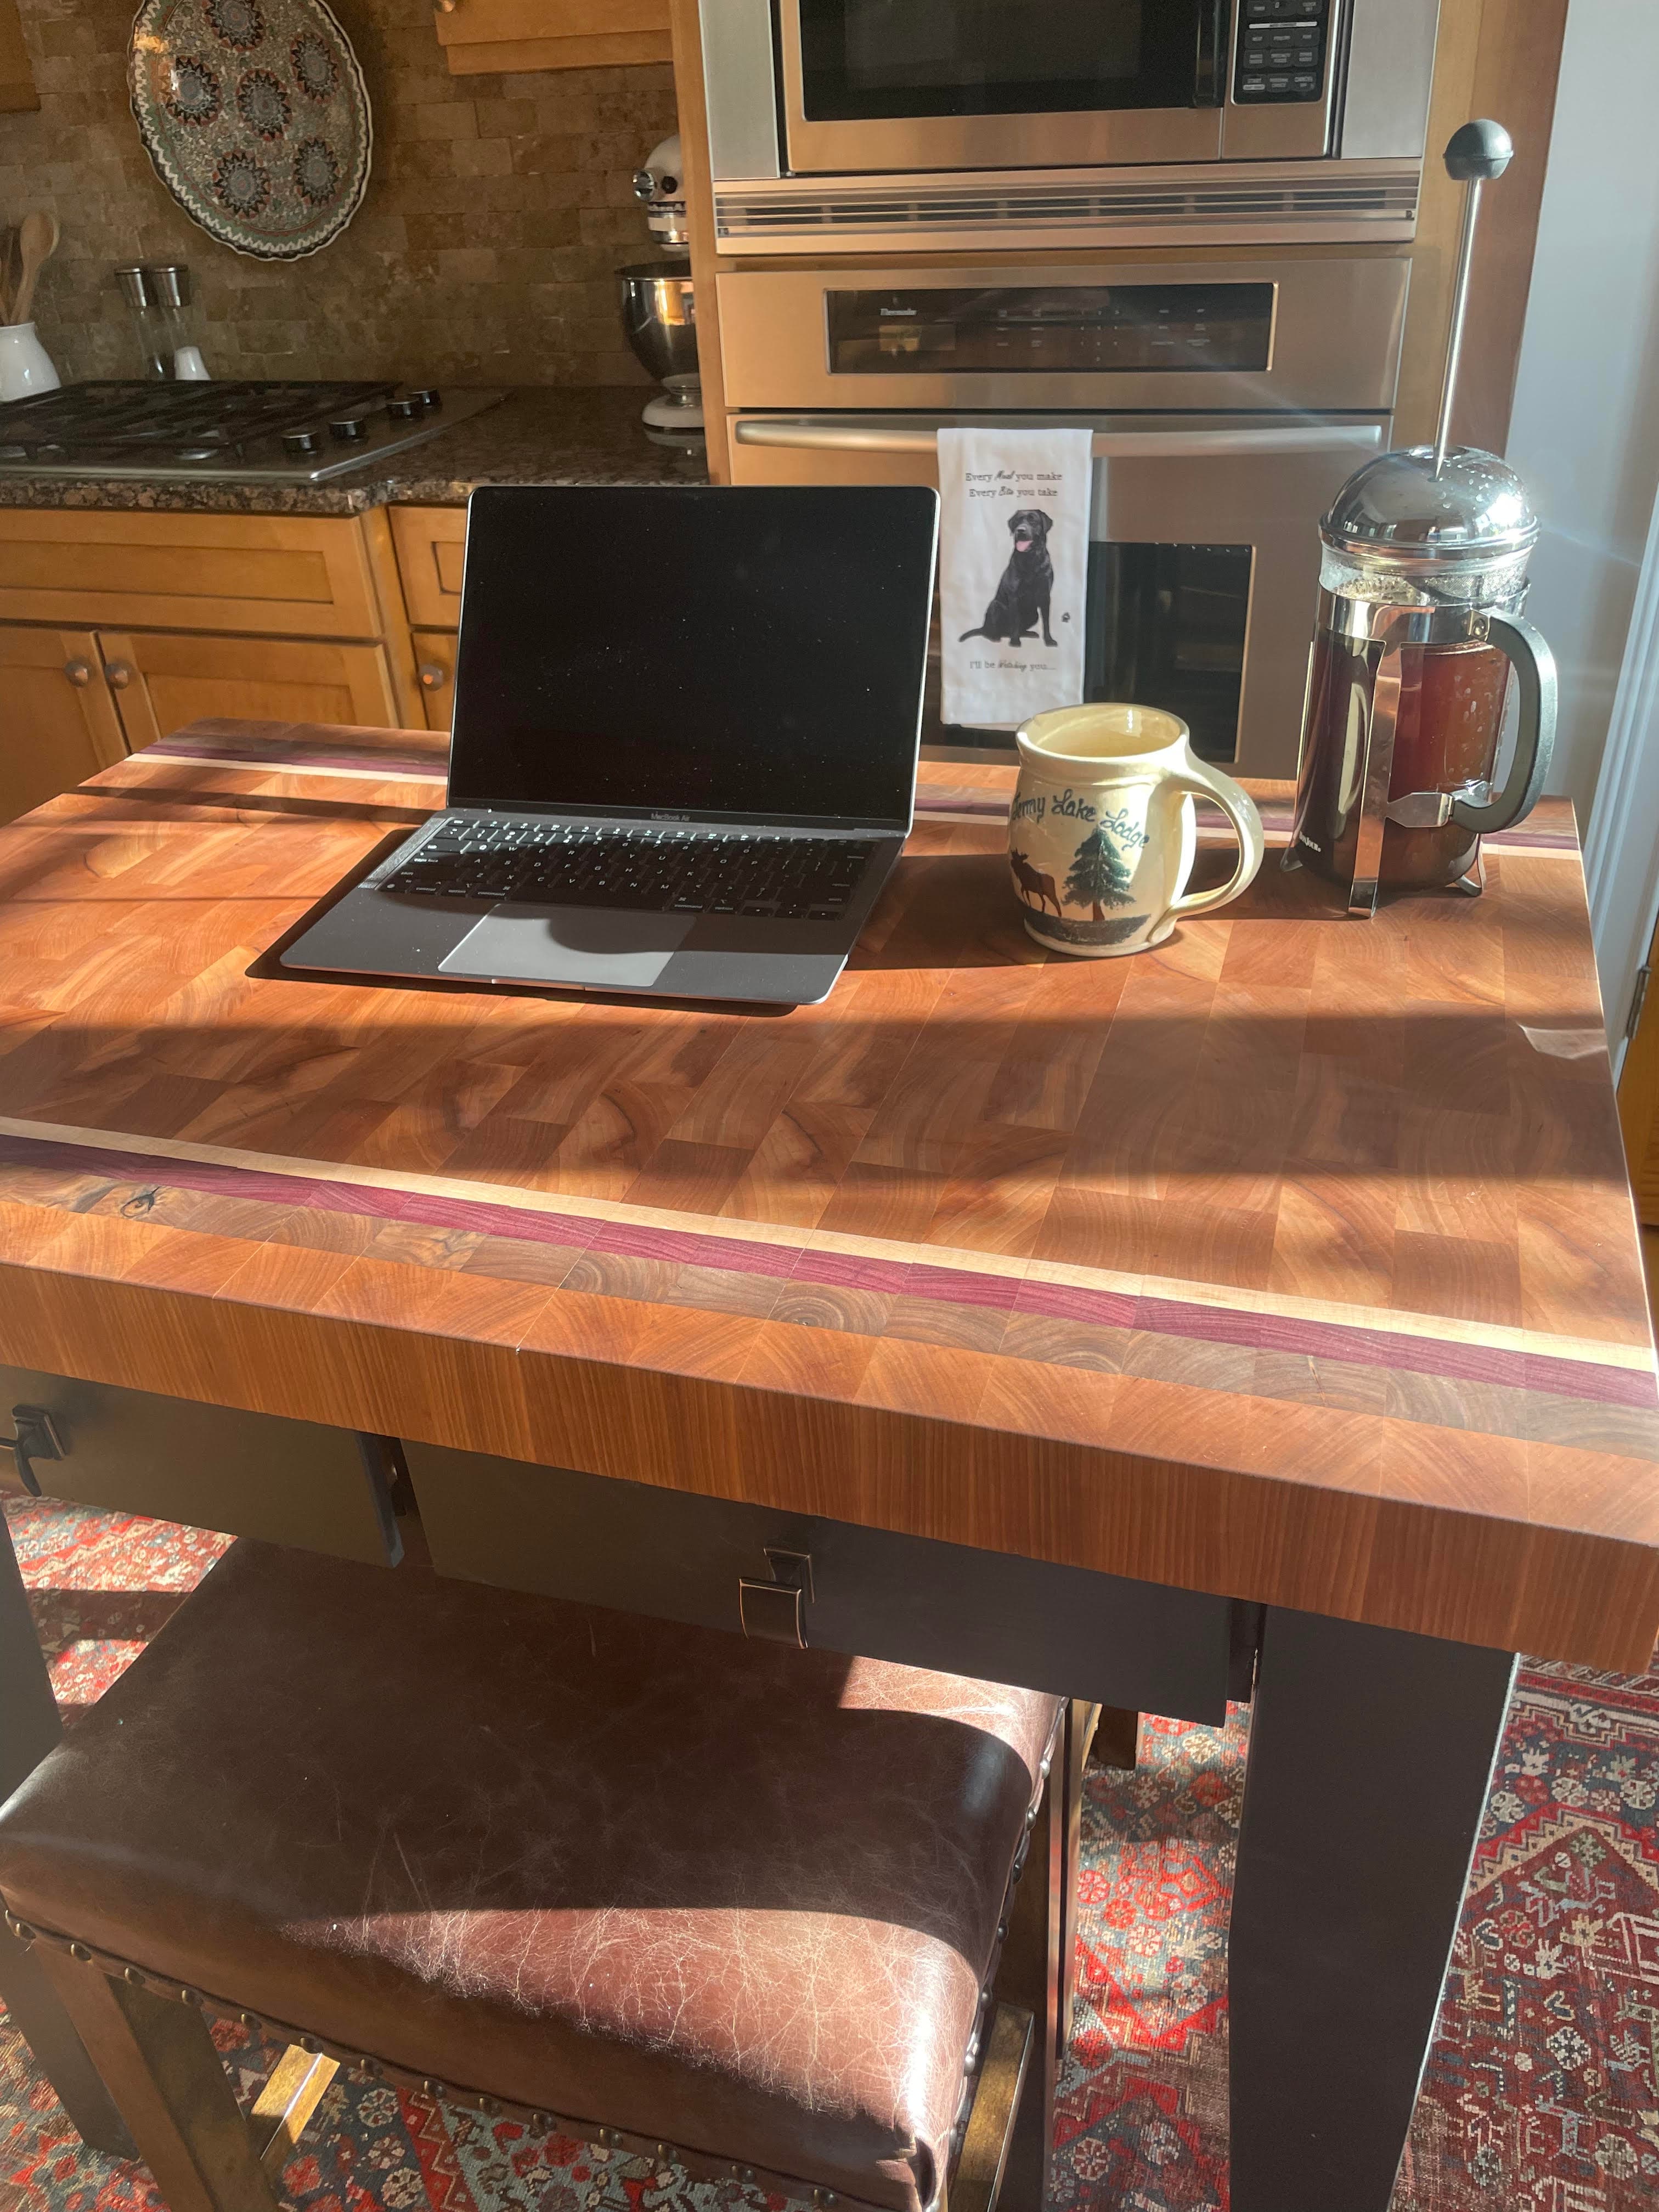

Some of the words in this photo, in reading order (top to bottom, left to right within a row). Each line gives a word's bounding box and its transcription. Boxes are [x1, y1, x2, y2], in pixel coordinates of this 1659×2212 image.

[966, 473, 993, 482] Every
[969, 489, 996, 498] Every
[651, 813, 680, 821] MacBook
[1051, 788, 1096, 822] Lake
[1100, 808, 1150, 851] Lodge
